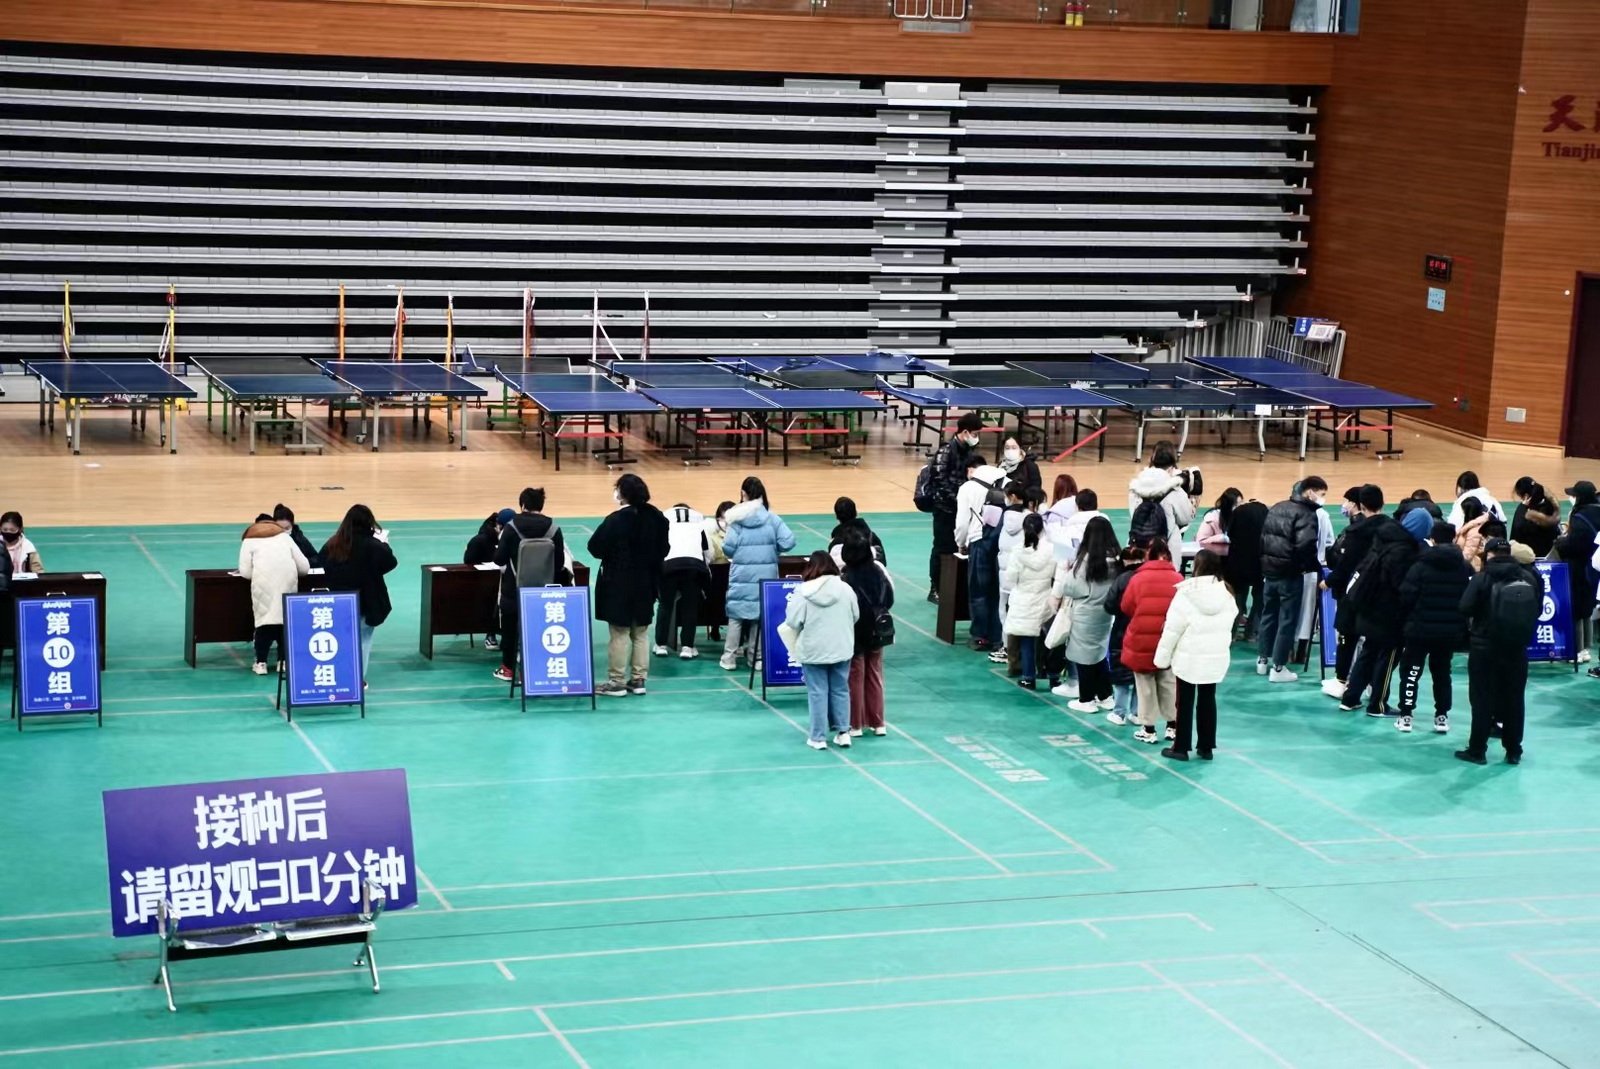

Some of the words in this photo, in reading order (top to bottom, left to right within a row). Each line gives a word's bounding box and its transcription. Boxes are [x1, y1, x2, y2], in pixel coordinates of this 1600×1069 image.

[1542, 94, 1600, 133] 天
[1541, 142, 1600, 162] Tianji
[675, 508, 689, 523] 11
[193, 788, 328, 850] 接种后
[120, 846, 407, 925] 请留观30分钟
